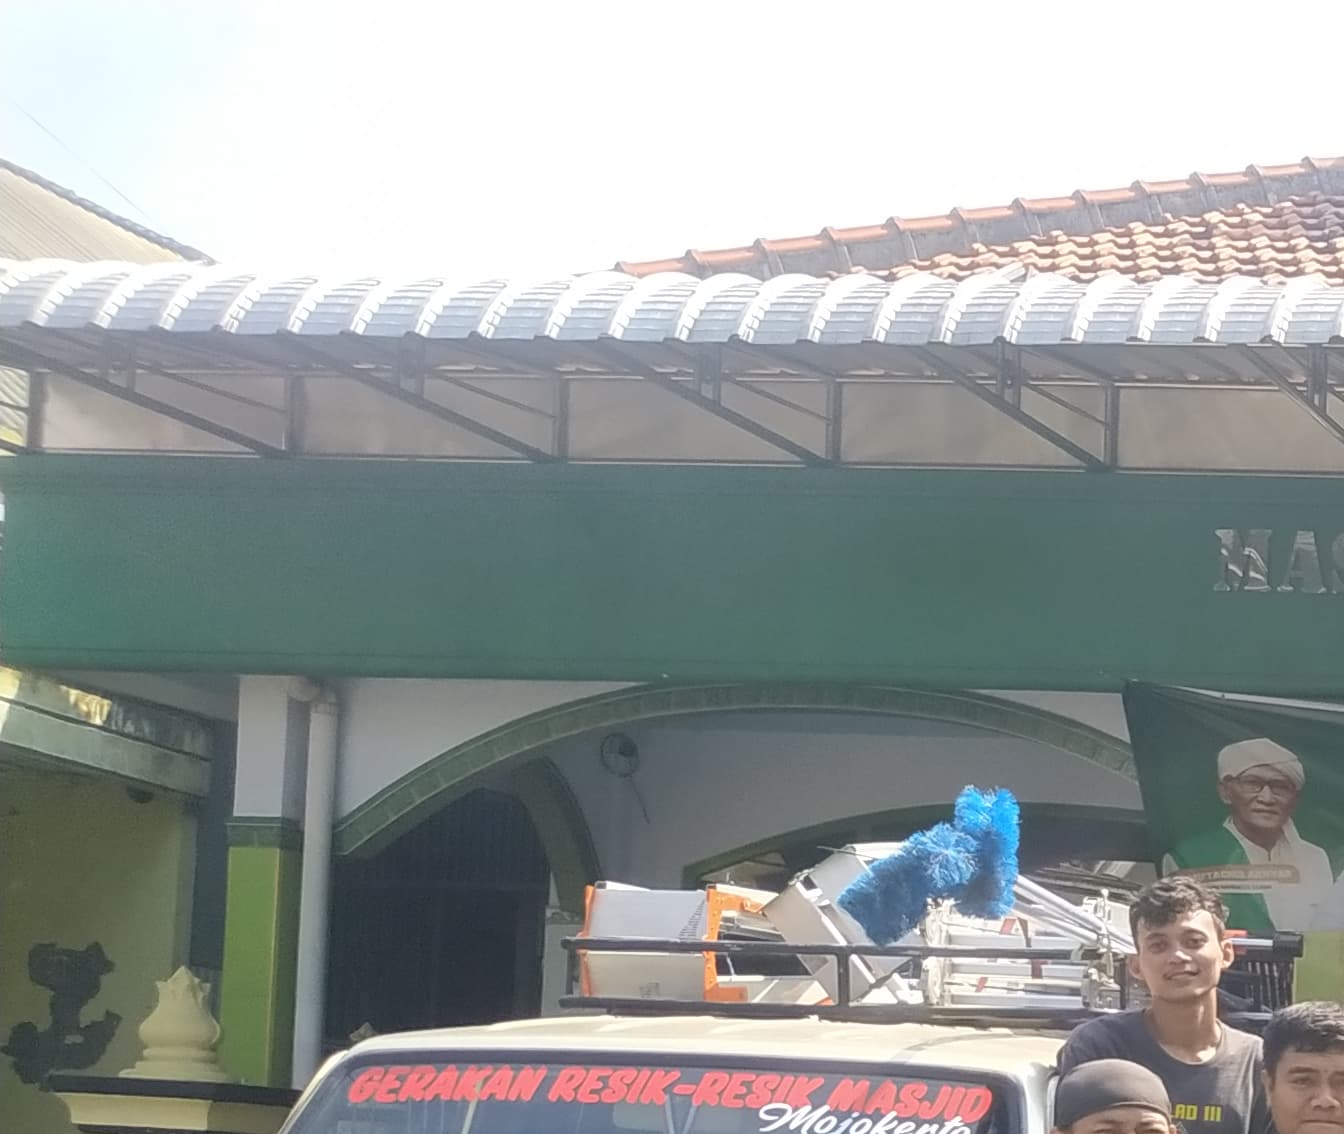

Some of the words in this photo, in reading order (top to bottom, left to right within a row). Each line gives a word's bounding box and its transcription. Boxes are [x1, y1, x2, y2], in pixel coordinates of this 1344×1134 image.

[347, 1065, 547, 1105] GERAKAN
[549, 1068, 824, 1112] RESIK-RESIK
[820, 1077, 993, 1124] MASJID
